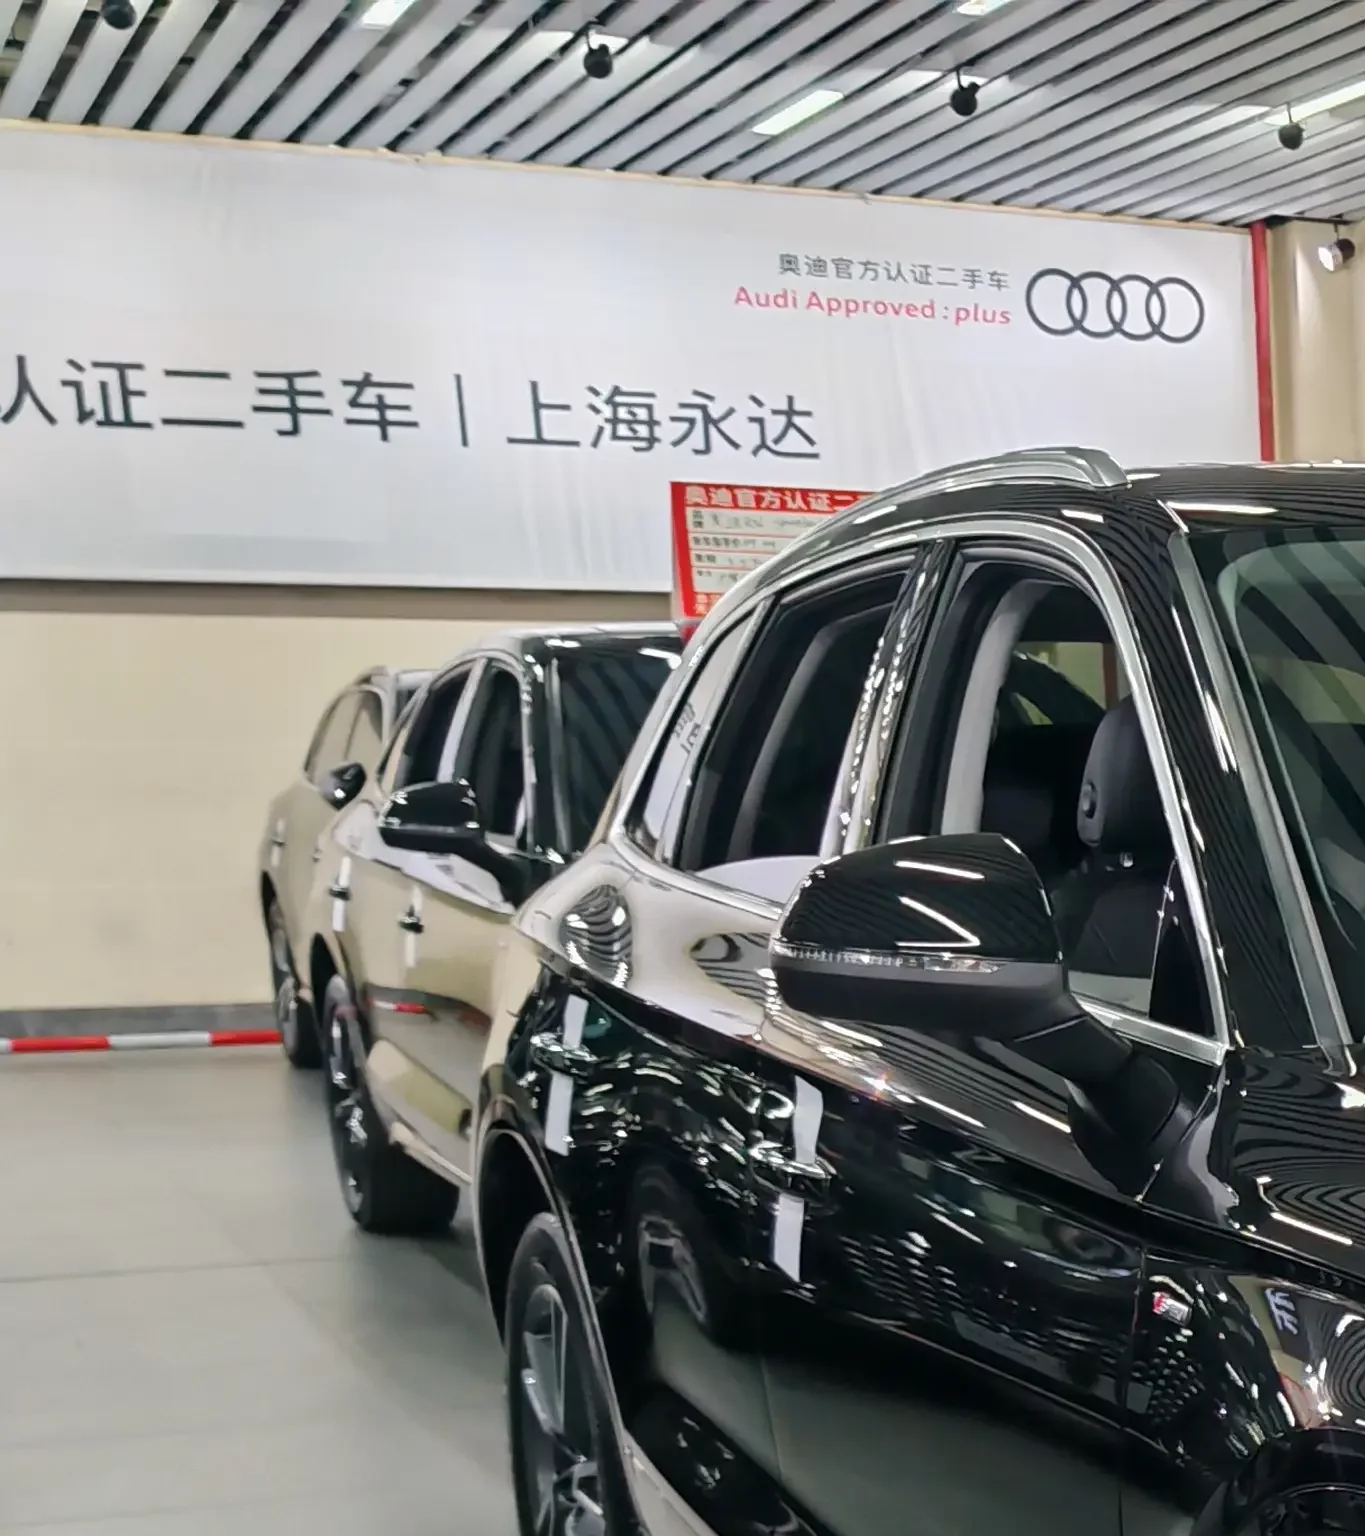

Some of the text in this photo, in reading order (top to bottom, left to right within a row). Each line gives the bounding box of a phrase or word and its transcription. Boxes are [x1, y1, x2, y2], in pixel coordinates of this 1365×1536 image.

[778, 253, 1010, 292] 奥迪官方认证二手车
[735, 286, 798, 309] Audi
[806, 291, 936, 319] Approved
[507, 380, 820, 460] 上海永达
